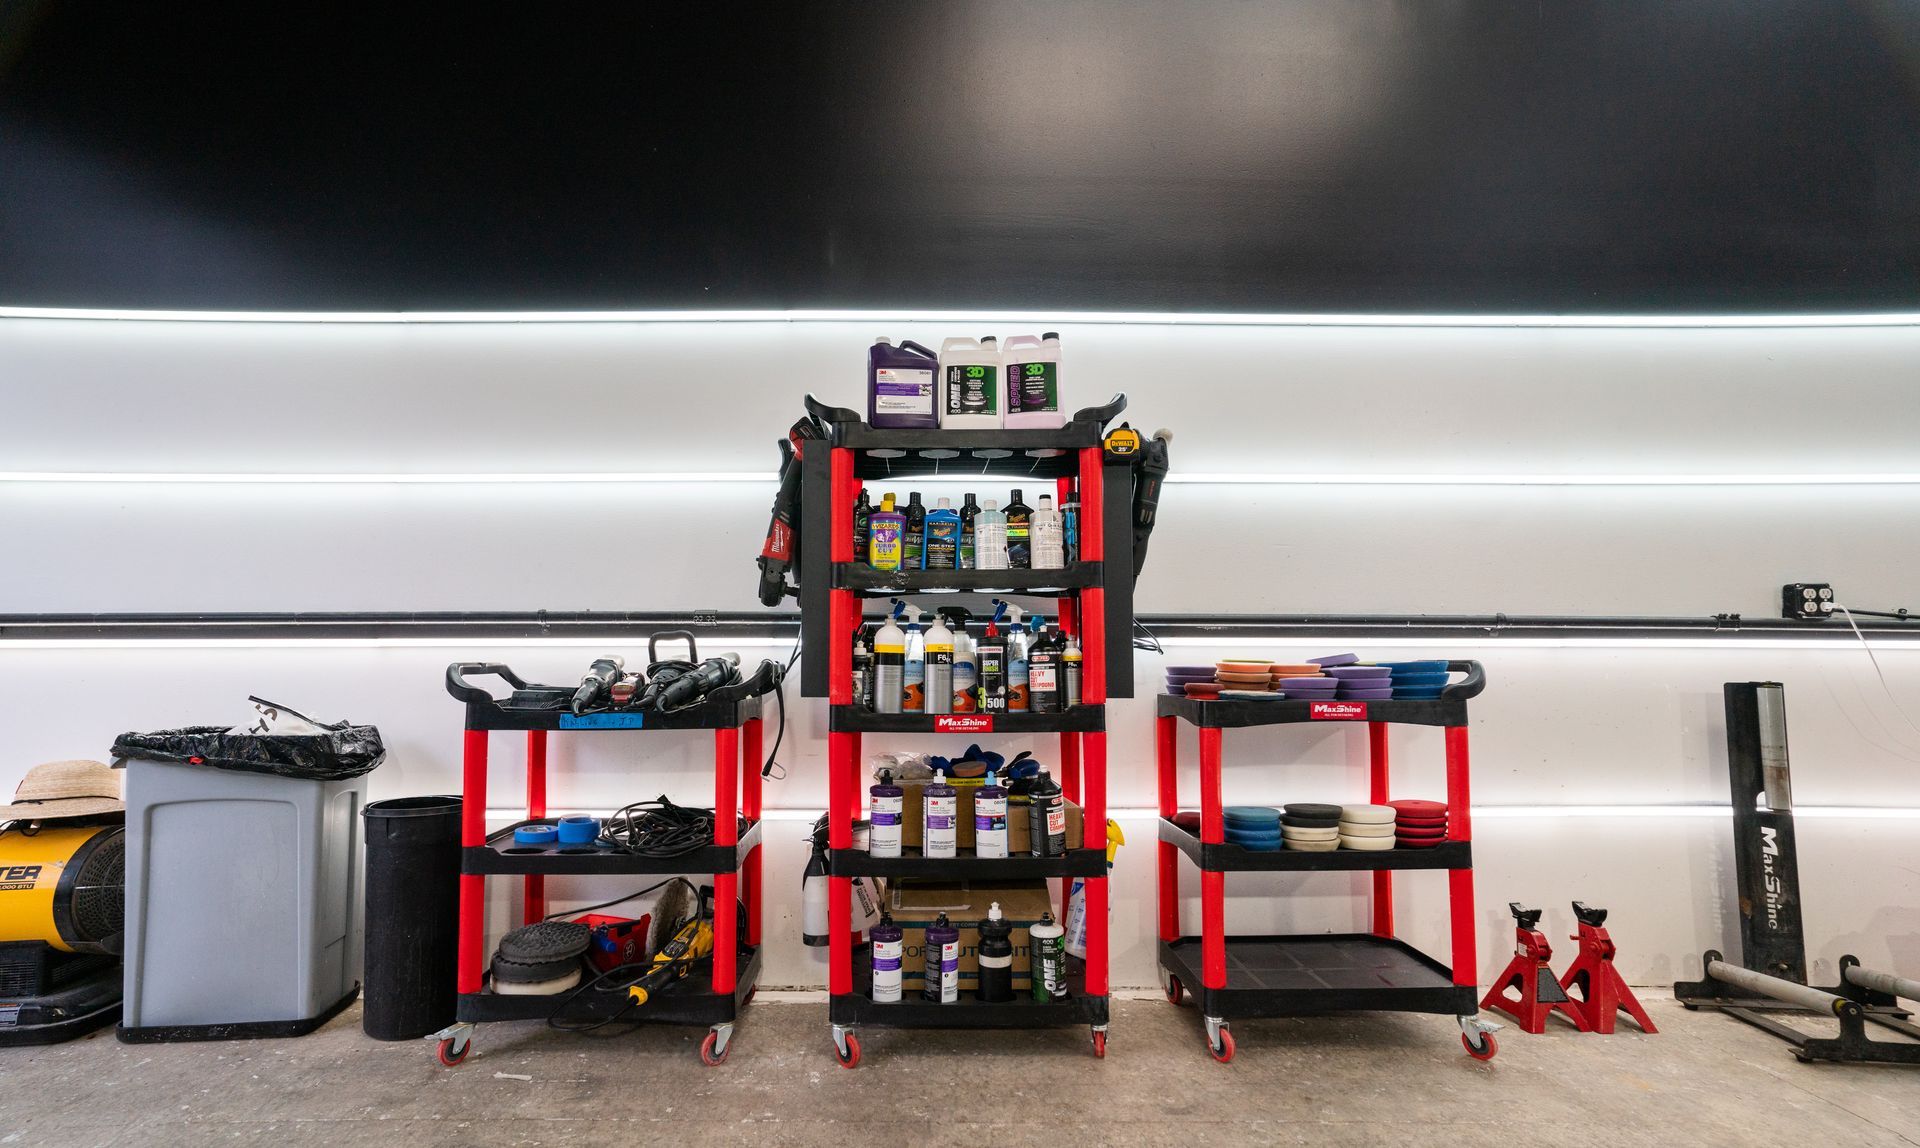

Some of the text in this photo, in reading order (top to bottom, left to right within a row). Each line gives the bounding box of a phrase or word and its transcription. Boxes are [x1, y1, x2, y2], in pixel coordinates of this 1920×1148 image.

[966, 366, 984, 378] 3D
[1025, 363, 1044, 376] 3D
[1010, 365, 1021, 407] SPEED
[950, 383, 960, 409] ONE
[1314, 704, 1362, 713] MaxShine
[938, 718, 987, 726] MaxShine
[1760, 826, 1782, 931] MaxShine
[1043, 958, 1057, 991] ONE
